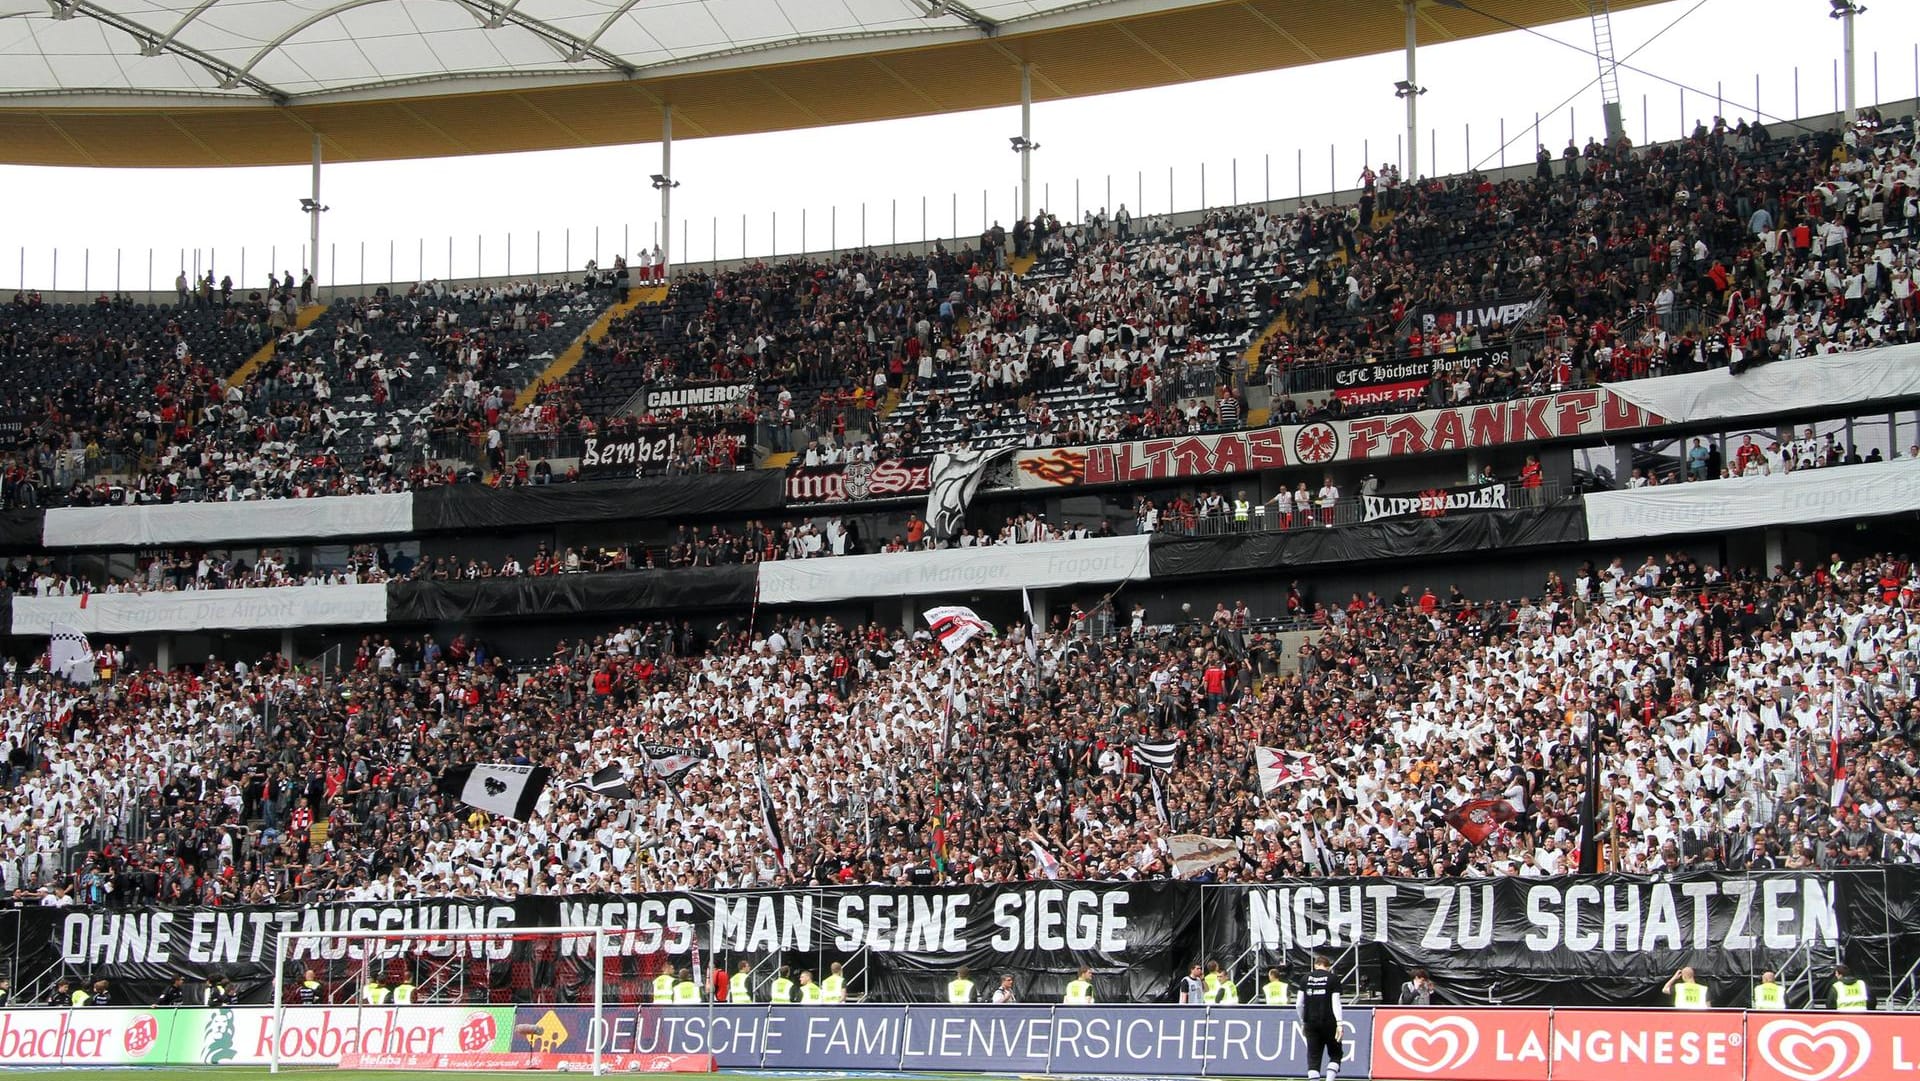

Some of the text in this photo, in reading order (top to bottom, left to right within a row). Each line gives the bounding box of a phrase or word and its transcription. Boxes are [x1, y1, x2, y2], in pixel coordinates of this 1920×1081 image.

[1336, 367, 1370, 385] EFC
[1374, 360, 1430, 380] Höchster
[785, 456, 934, 502] ing Sz
[1084, 427, 1289, 486] ULTRAS
[1362, 483, 1508, 523] KLIPPENADLER
[63, 912, 174, 964] OHNE
[560, 899, 694, 957] WEISS
[711, 893, 813, 955] MAN
[835, 892, 971, 953] SEINE
[991, 889, 1131, 953] SIEGE
[1248, 884, 1397, 950] NICHT
[1420, 882, 1494, 951] ZU
[1525, 872, 1840, 951] SCHÄTZEN
[255, 1010, 445, 1058] Rosbacher
[585, 1016, 786, 1055] DEUTSCHE
